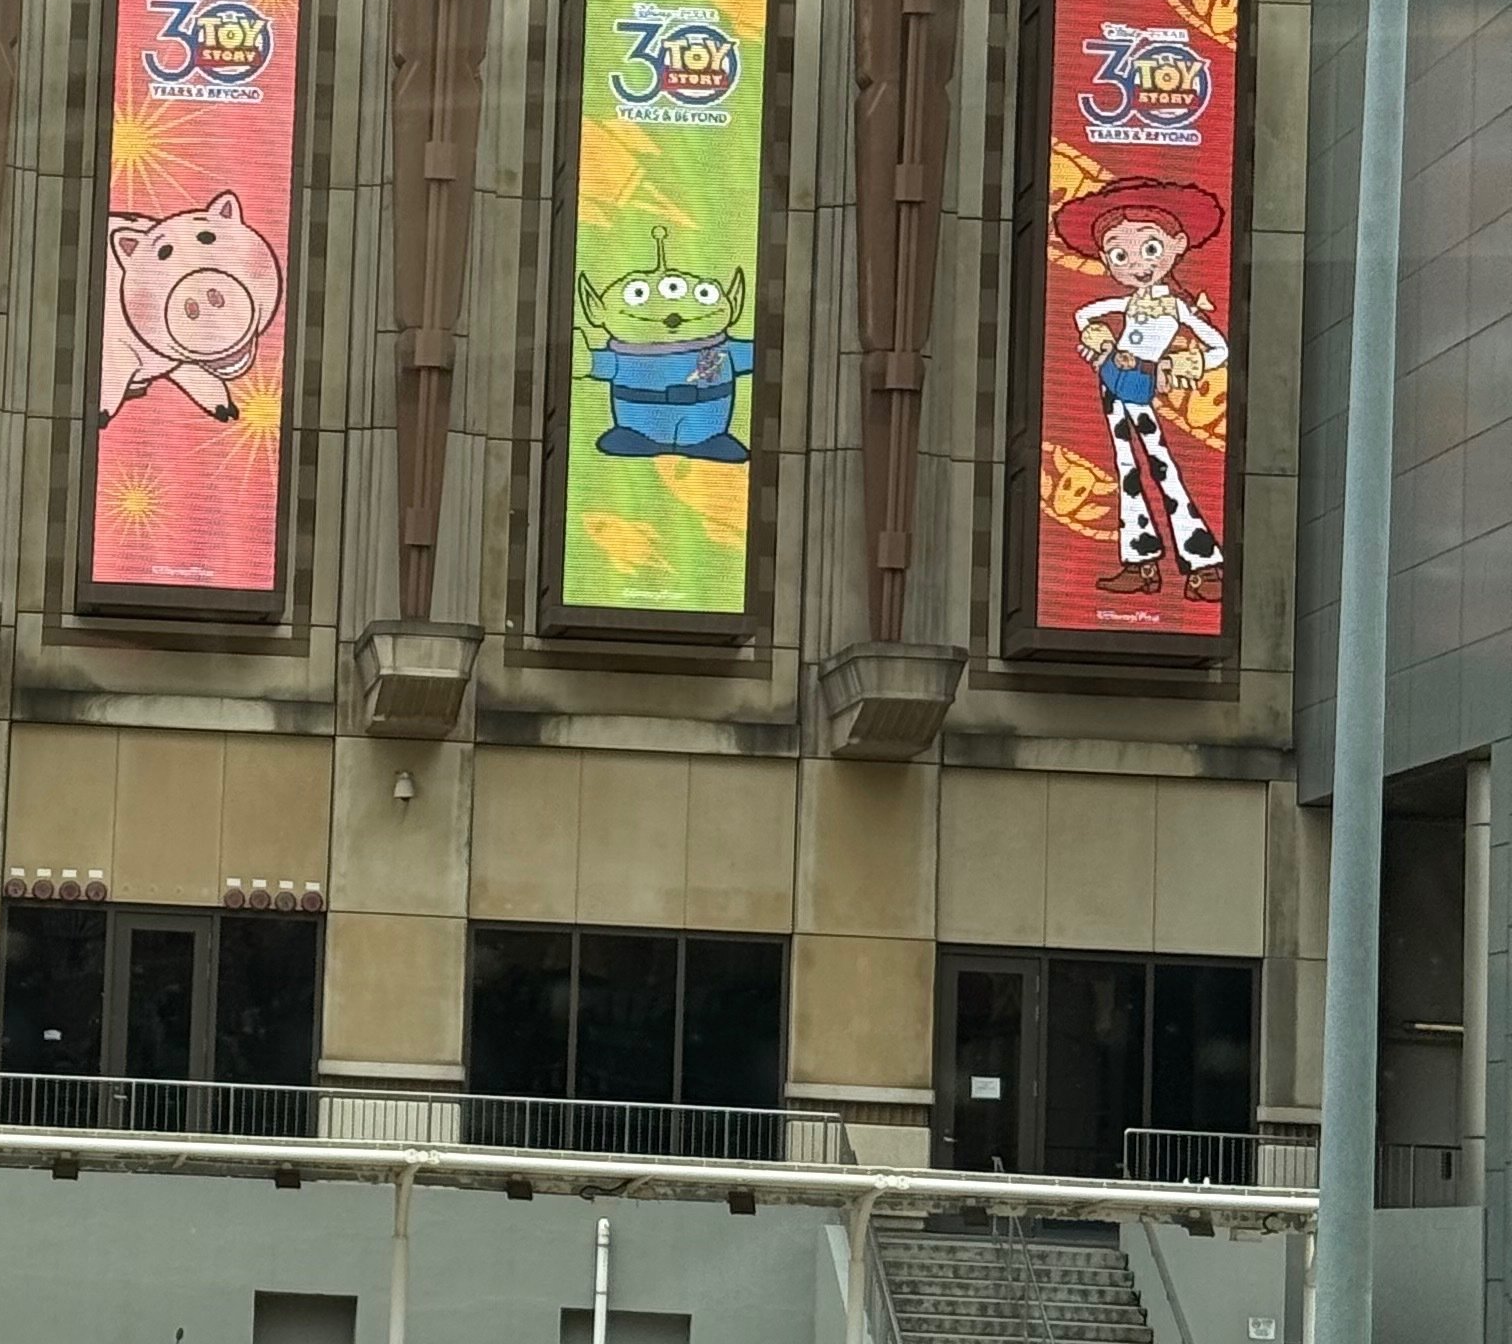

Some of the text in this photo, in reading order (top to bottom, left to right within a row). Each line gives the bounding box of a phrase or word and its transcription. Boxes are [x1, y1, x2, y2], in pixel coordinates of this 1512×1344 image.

[197, 17, 266, 49] TOY
[202, 50, 256, 62] STORY
[663, 39, 731, 71] TOY
[668, 73, 723, 86] STORY
[1133, 60, 1203, 91] TOY
[152, 85, 192, 97] YEARS
[207, 88, 260, 100] BEYOND
[1138, 92, 1194, 105] STORY
[618, 107, 659, 121] YEARS
[675, 111, 728, 124] BEYOND
[1089, 129, 1130, 141] YEARS
[1144, 131, 1199, 144] BEYOND
